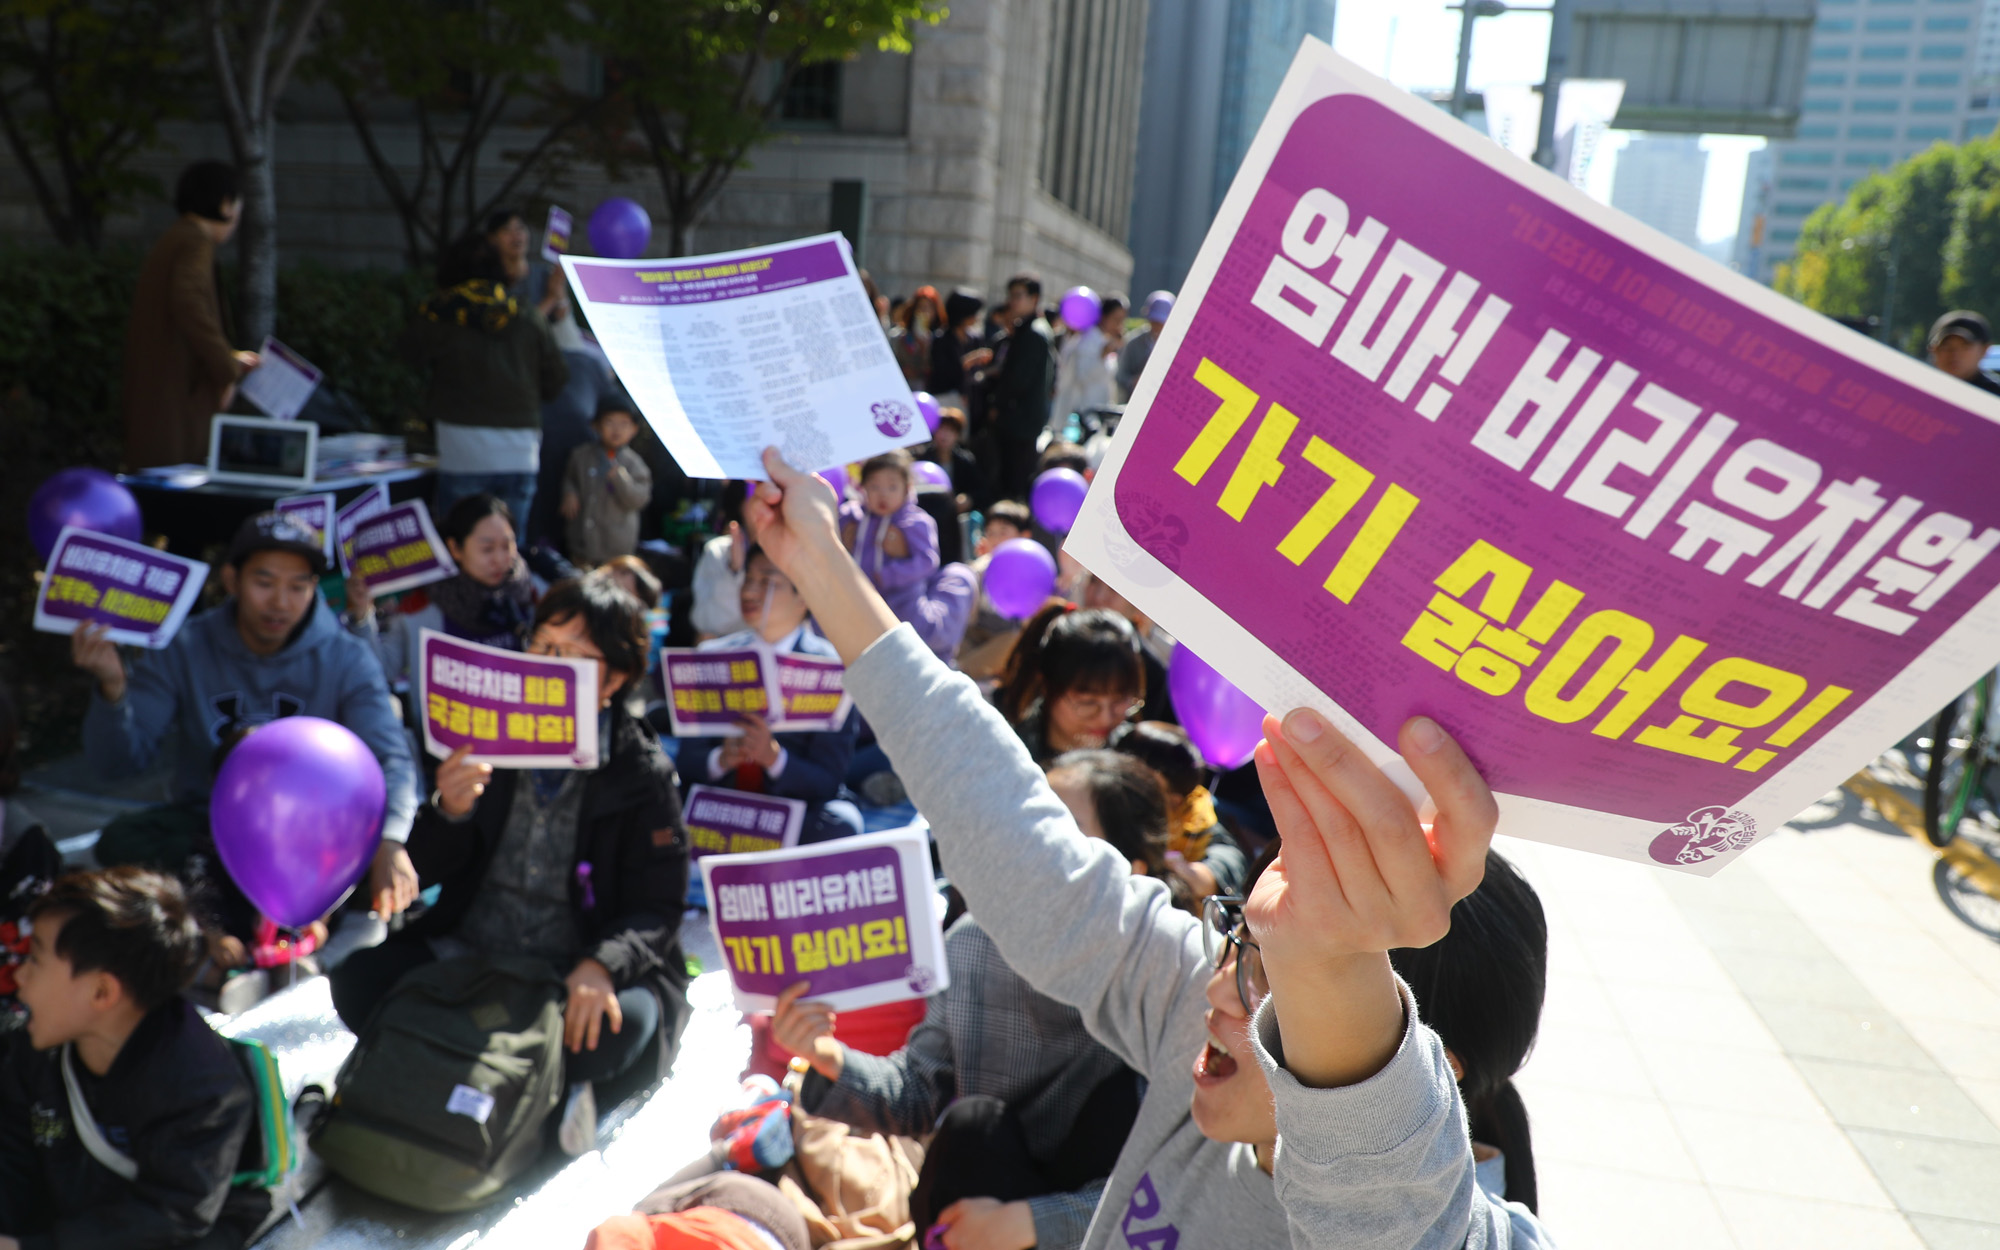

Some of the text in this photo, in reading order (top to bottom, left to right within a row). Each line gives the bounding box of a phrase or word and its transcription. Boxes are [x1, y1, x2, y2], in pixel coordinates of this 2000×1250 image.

[1251, 187, 2000, 636] 엄마! 비리유치원
[1173, 356, 1853, 772] 가기 싫어요!
[432, 654, 522, 703] 비리유치원
[719, 864, 898, 922] 엄마! 비리유치원
[724, 916, 908, 975] 가기 싫어요!
